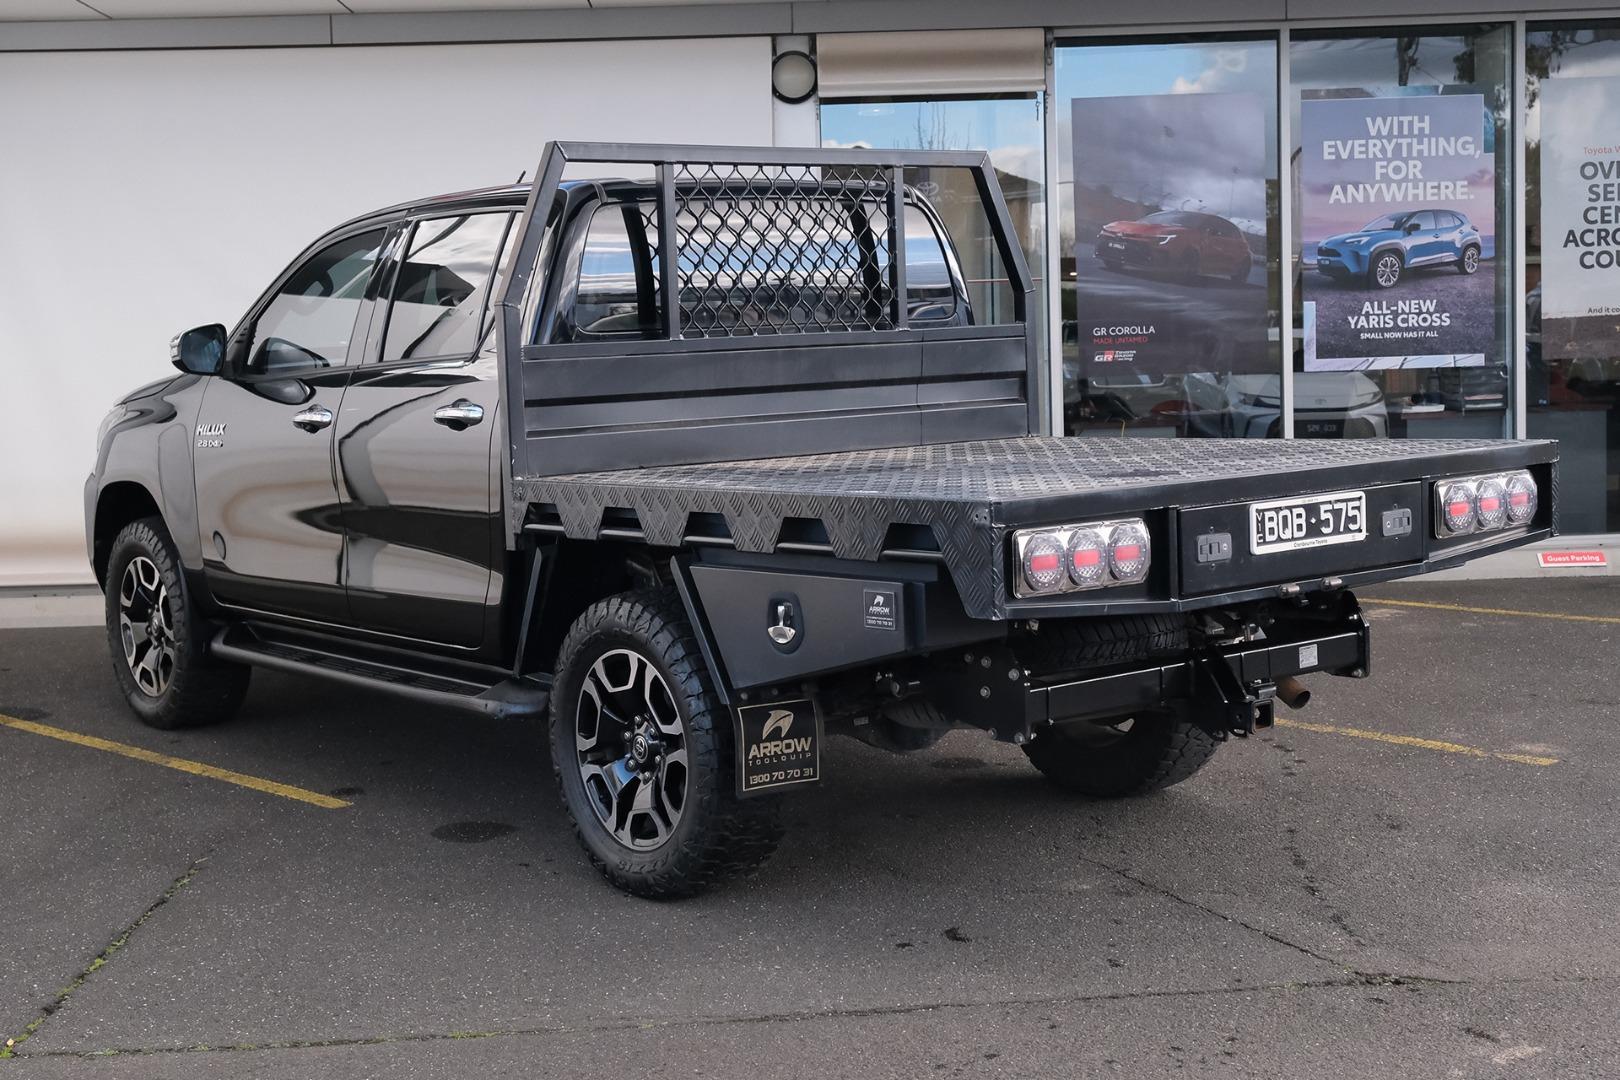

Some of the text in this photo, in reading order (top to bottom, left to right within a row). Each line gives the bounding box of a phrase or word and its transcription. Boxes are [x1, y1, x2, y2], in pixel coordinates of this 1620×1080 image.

[1366, 115, 1430, 136] WITH
[1323, 136, 1480, 160] EVERYTHING,
[1584, 147, 1612, 155] Toyota
[1375, 160, 1423, 180] FOR
[1329, 181, 1475, 204] ANYWHERE.
[1588, 183, 1620, 202] SE
[1579, 250, 1620, 270] CO
[1361, 299, 1437, 315] ALL-NEW
[1347, 313, 1451, 329] YARIS CROSS
[1093, 326, 1155, 336] GR COROLLA
[197, 423, 227, 436] HILUX
[1264, 501, 1361, 542] BQB 575
[748, 737, 812, 760] ARROW
[749, 767, 813, 785] 1300 70 70 31
